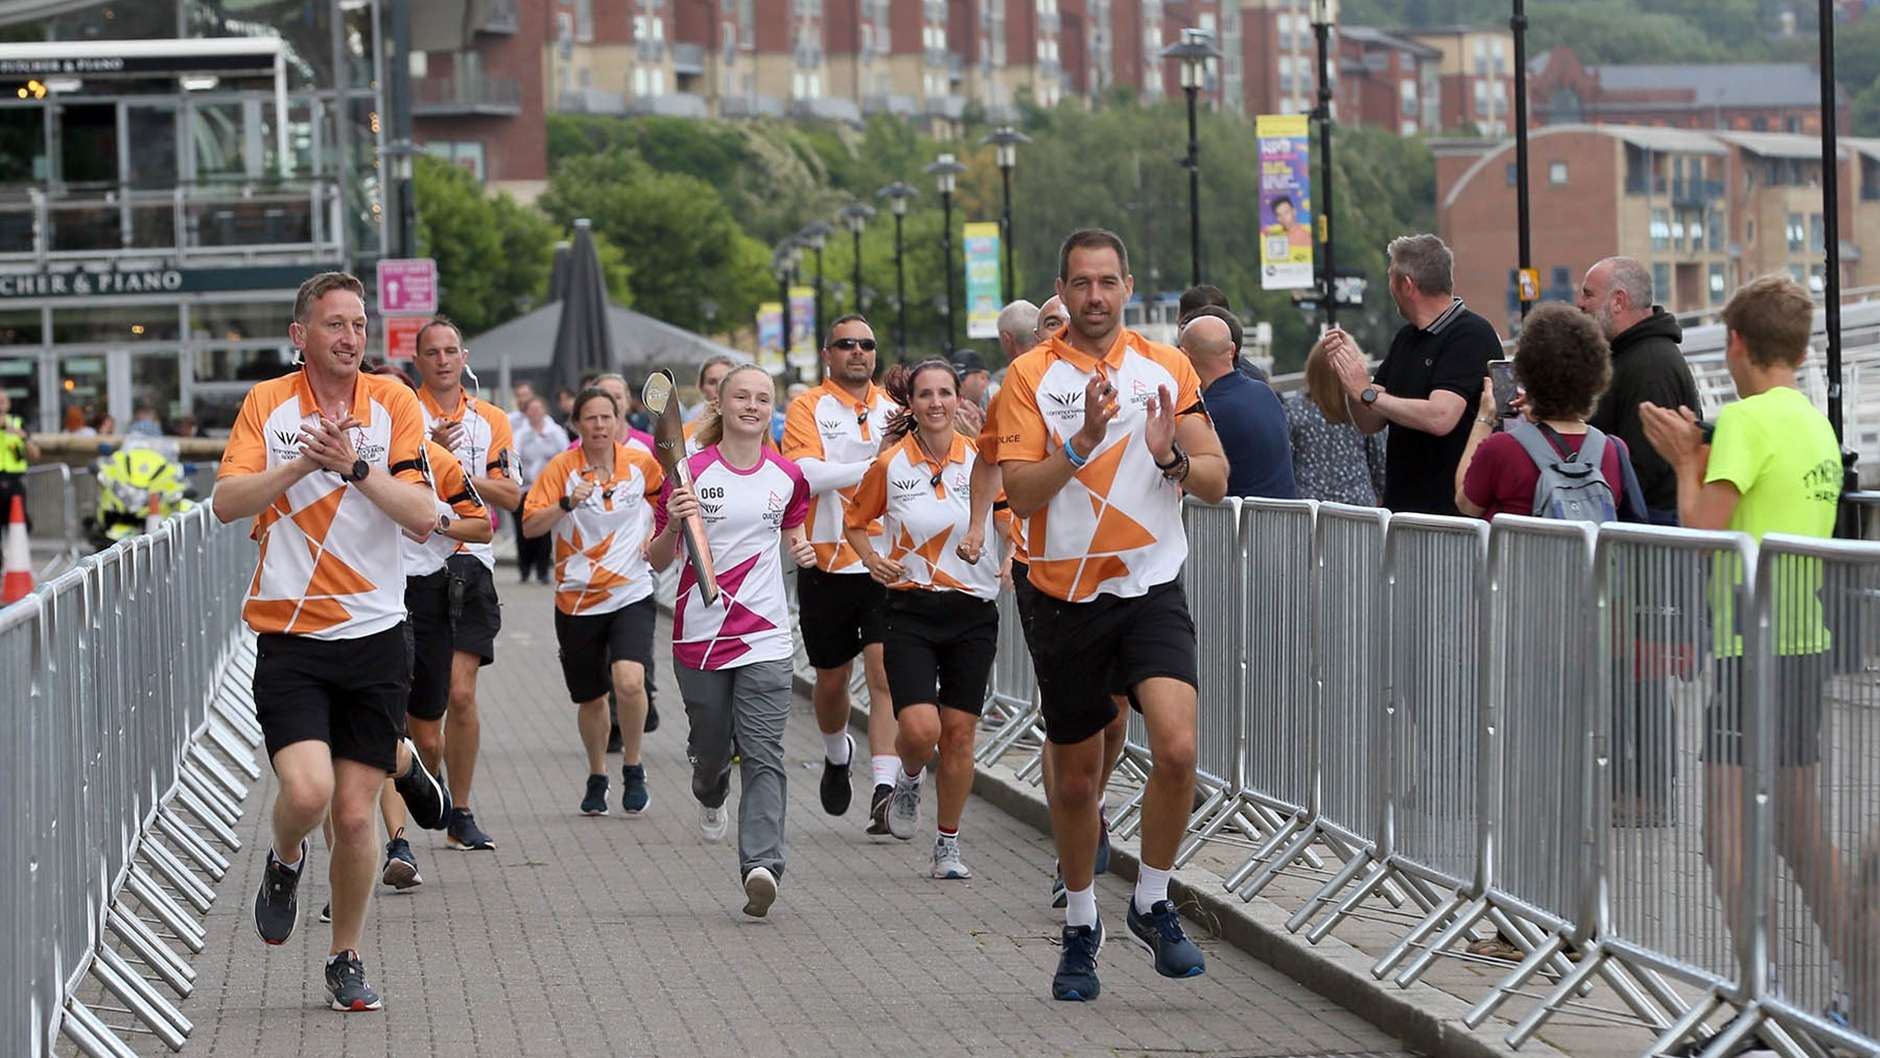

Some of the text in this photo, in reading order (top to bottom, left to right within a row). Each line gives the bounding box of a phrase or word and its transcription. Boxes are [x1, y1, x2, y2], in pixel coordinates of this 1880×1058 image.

[73, 271, 91, 294] &
[99, 270, 182, 292] PIANO
[701, 487, 724, 499] 068
